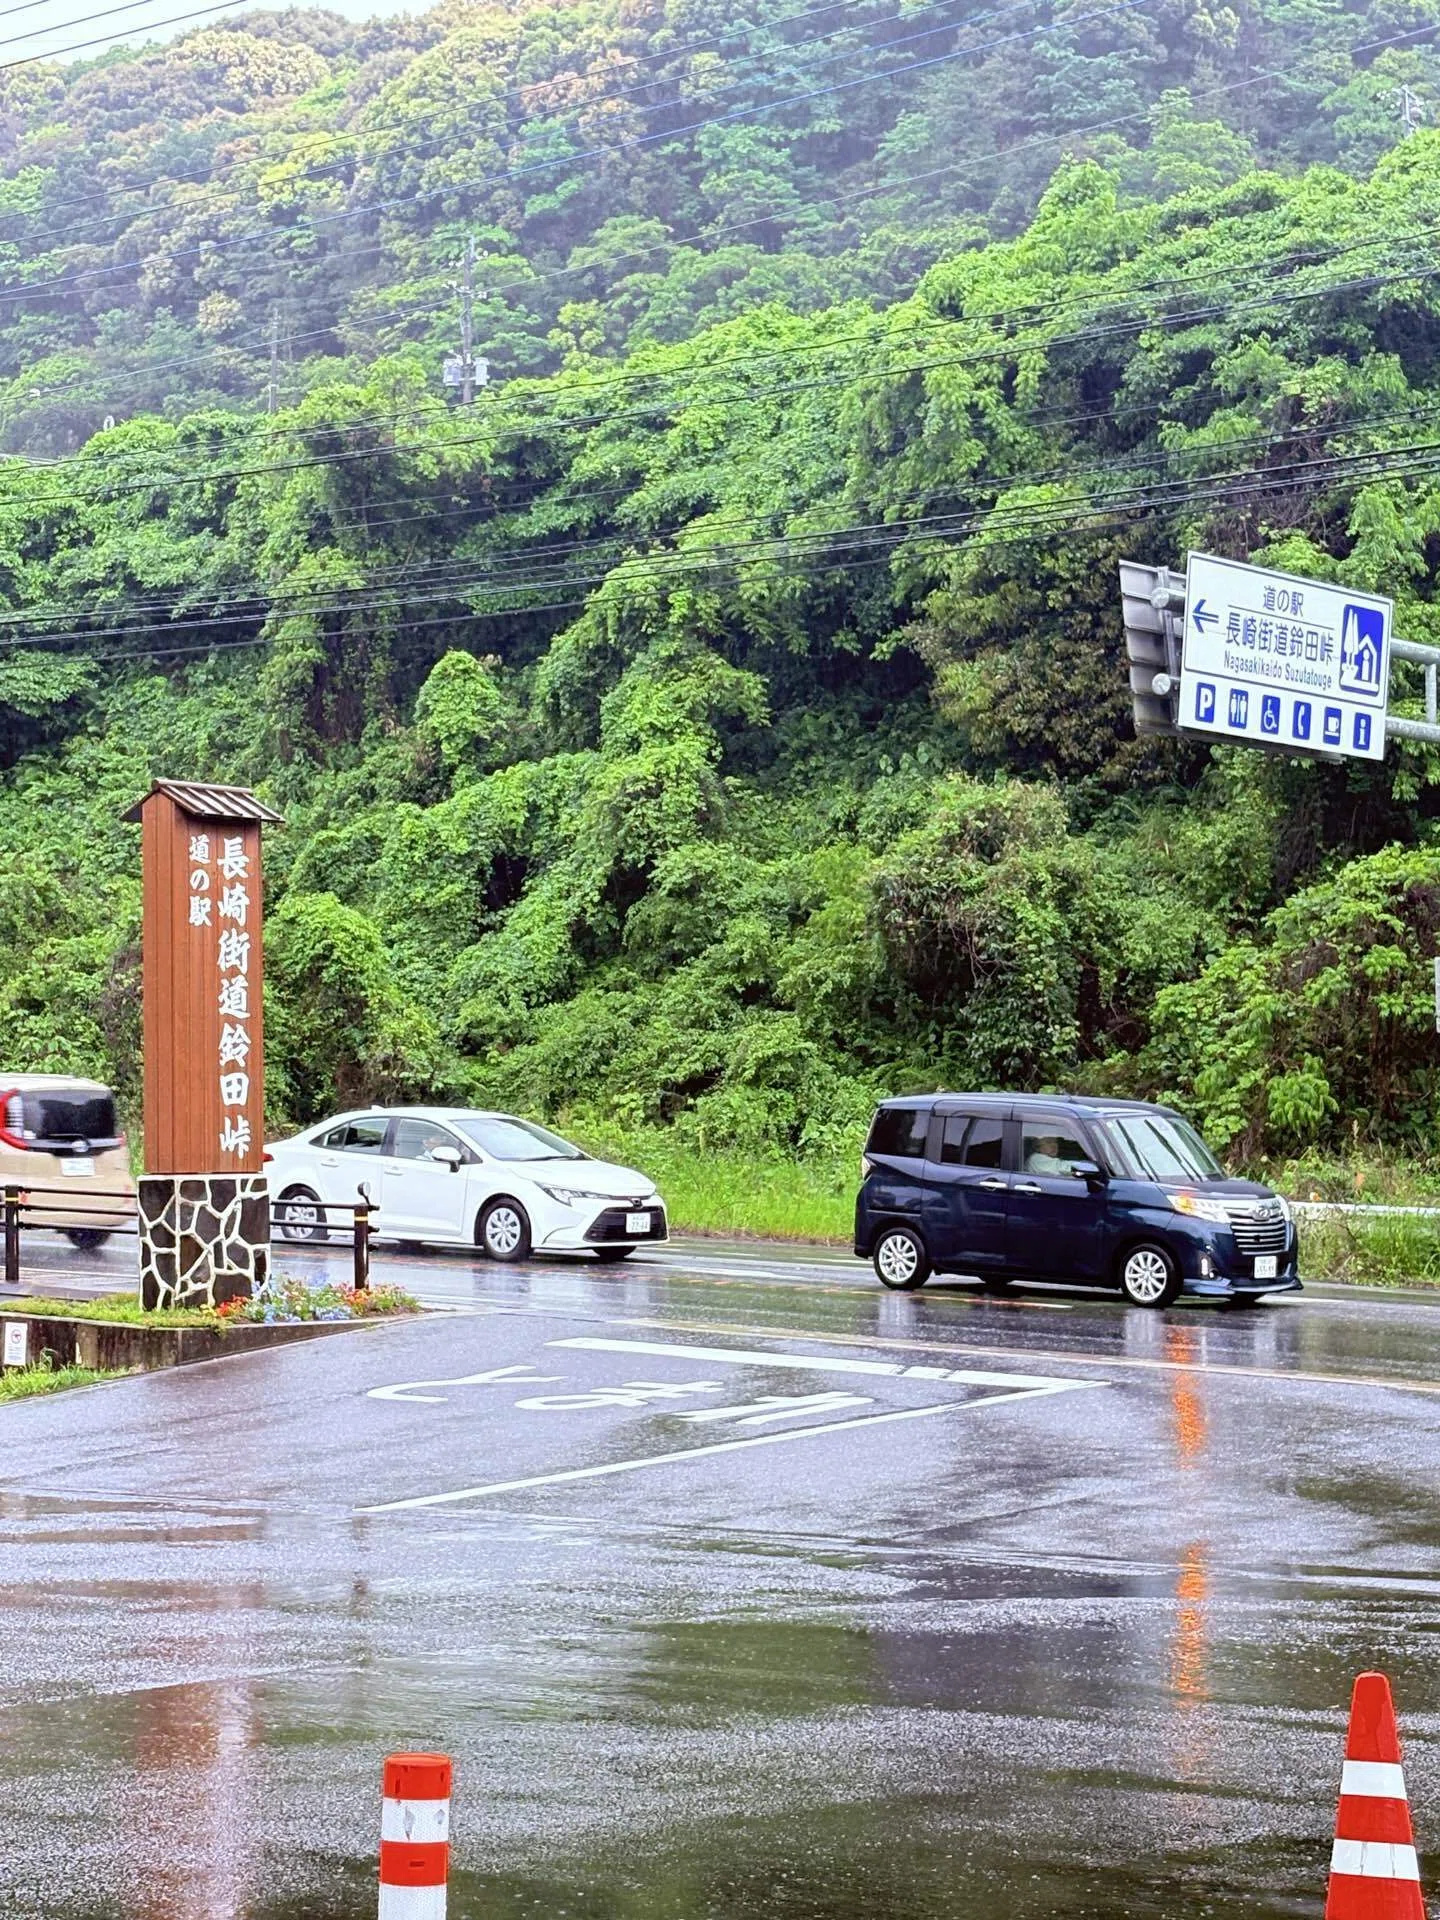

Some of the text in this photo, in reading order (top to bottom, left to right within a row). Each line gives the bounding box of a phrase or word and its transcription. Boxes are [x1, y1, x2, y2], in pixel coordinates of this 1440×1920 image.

[1263, 585, 1304, 617] 道の駅
[1226, 612, 1334, 665] 長崎街道鈴田峠
[1224, 650, 1332, 691] Nagasakikaido Suzutatouge
[190, 836, 213, 927] 道の駅
[218, 838, 252, 1160] 長崎街道鈴田峠
